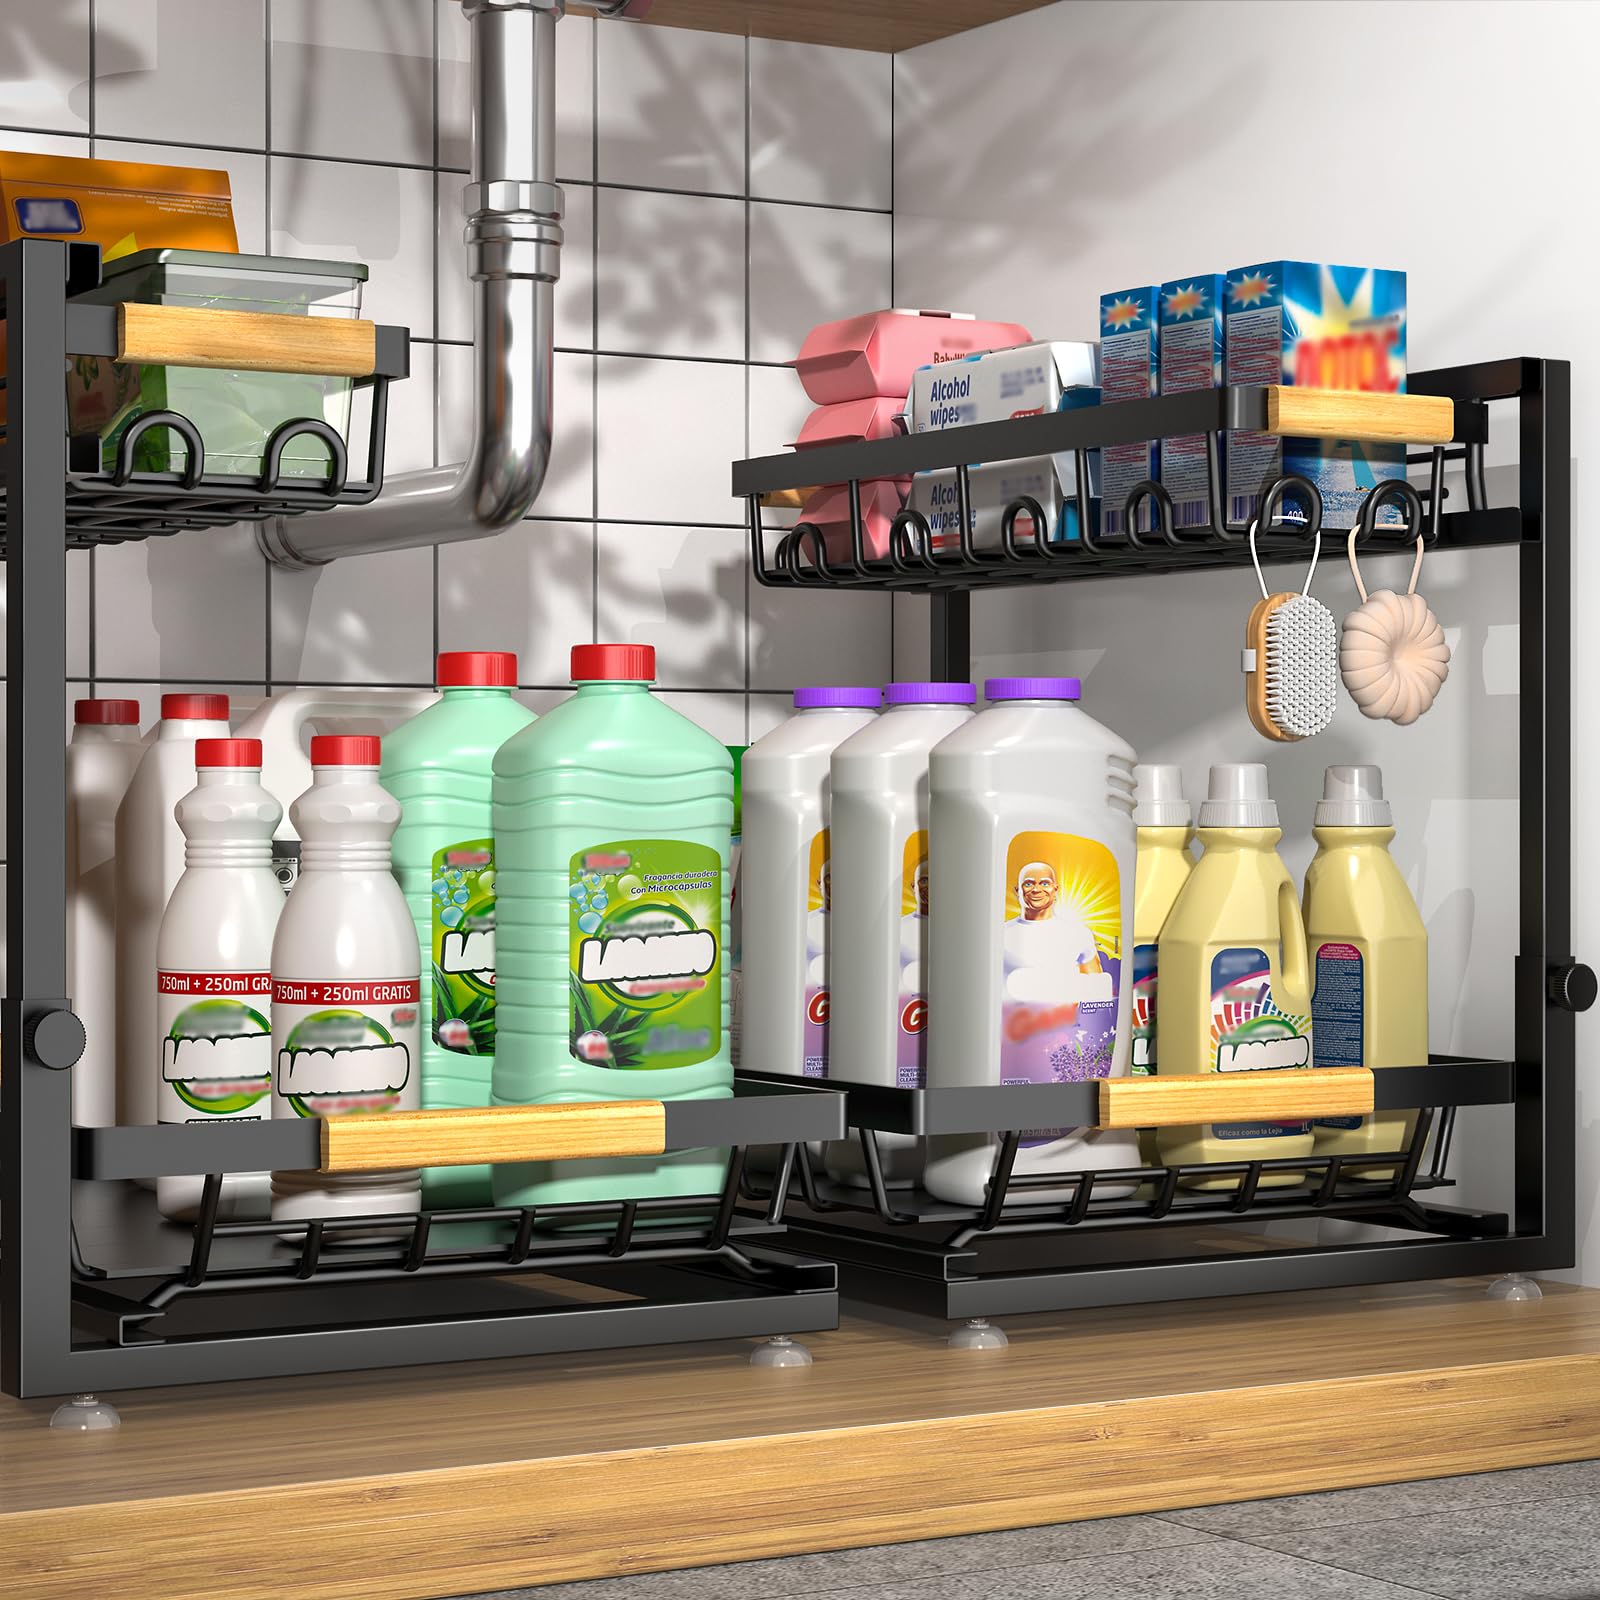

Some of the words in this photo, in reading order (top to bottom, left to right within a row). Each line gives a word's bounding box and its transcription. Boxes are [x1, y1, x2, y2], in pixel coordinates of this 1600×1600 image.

[930, 374, 970, 402] Alcohol
[930, 402, 959, 431] wipes
[931, 506, 959, 534] wipes
[643, 874, 683, 882] Fragancia
[161, 976, 190, 991] 750ml
[194, 980, 201, 988] +
[205, 977, 249, 991] 250ml
[252, 976, 272, 991] GR
[276, 985, 307, 1001] 750ml
[311, 990, 319, 998] +
[323, 985, 368, 1001] 250ml
[372, 985, 411, 1000] GRATIS
[1241, 1128, 1260, 1136] como
